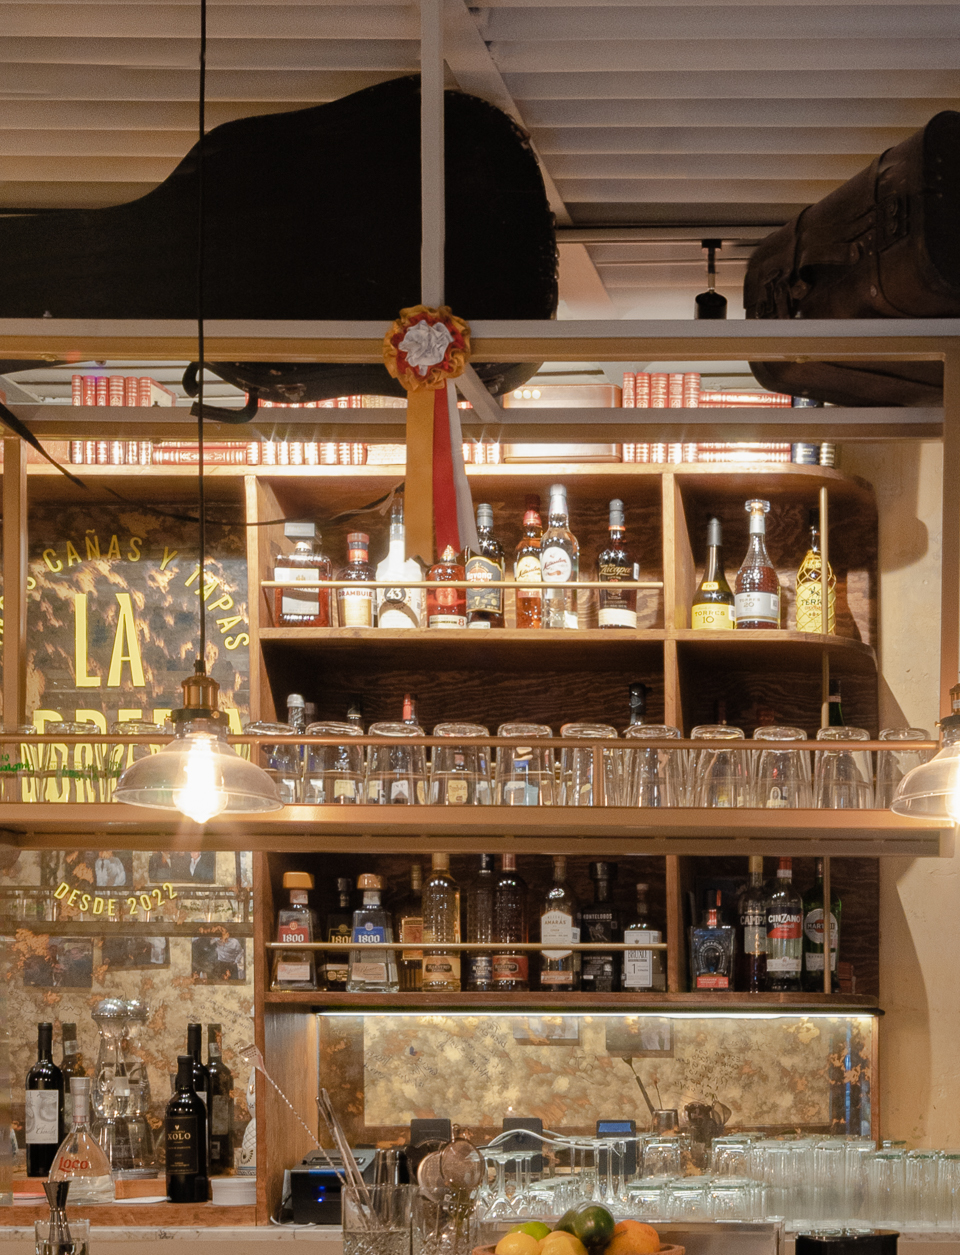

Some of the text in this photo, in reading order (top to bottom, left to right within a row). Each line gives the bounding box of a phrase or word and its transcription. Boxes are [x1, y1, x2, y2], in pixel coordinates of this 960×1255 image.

[42, 529, 250, 650] CAÑAS Y TAPAS
[338, 590, 373, 598] DRAMBUIE
[386, 588, 402, 600] 43
[801, 598, 822, 606] TERR
[702, 616, 715, 624] 10
[74, 592, 146, 688] LA
[53, 881, 116, 916] DESDE
[127, 882, 178, 915] 2022
[740, 916, 766, 925] CAMPA
[768, 913, 801, 924] CINZANO
[282, 933, 305, 943] 1800
[358, 934, 381, 943] 1800
